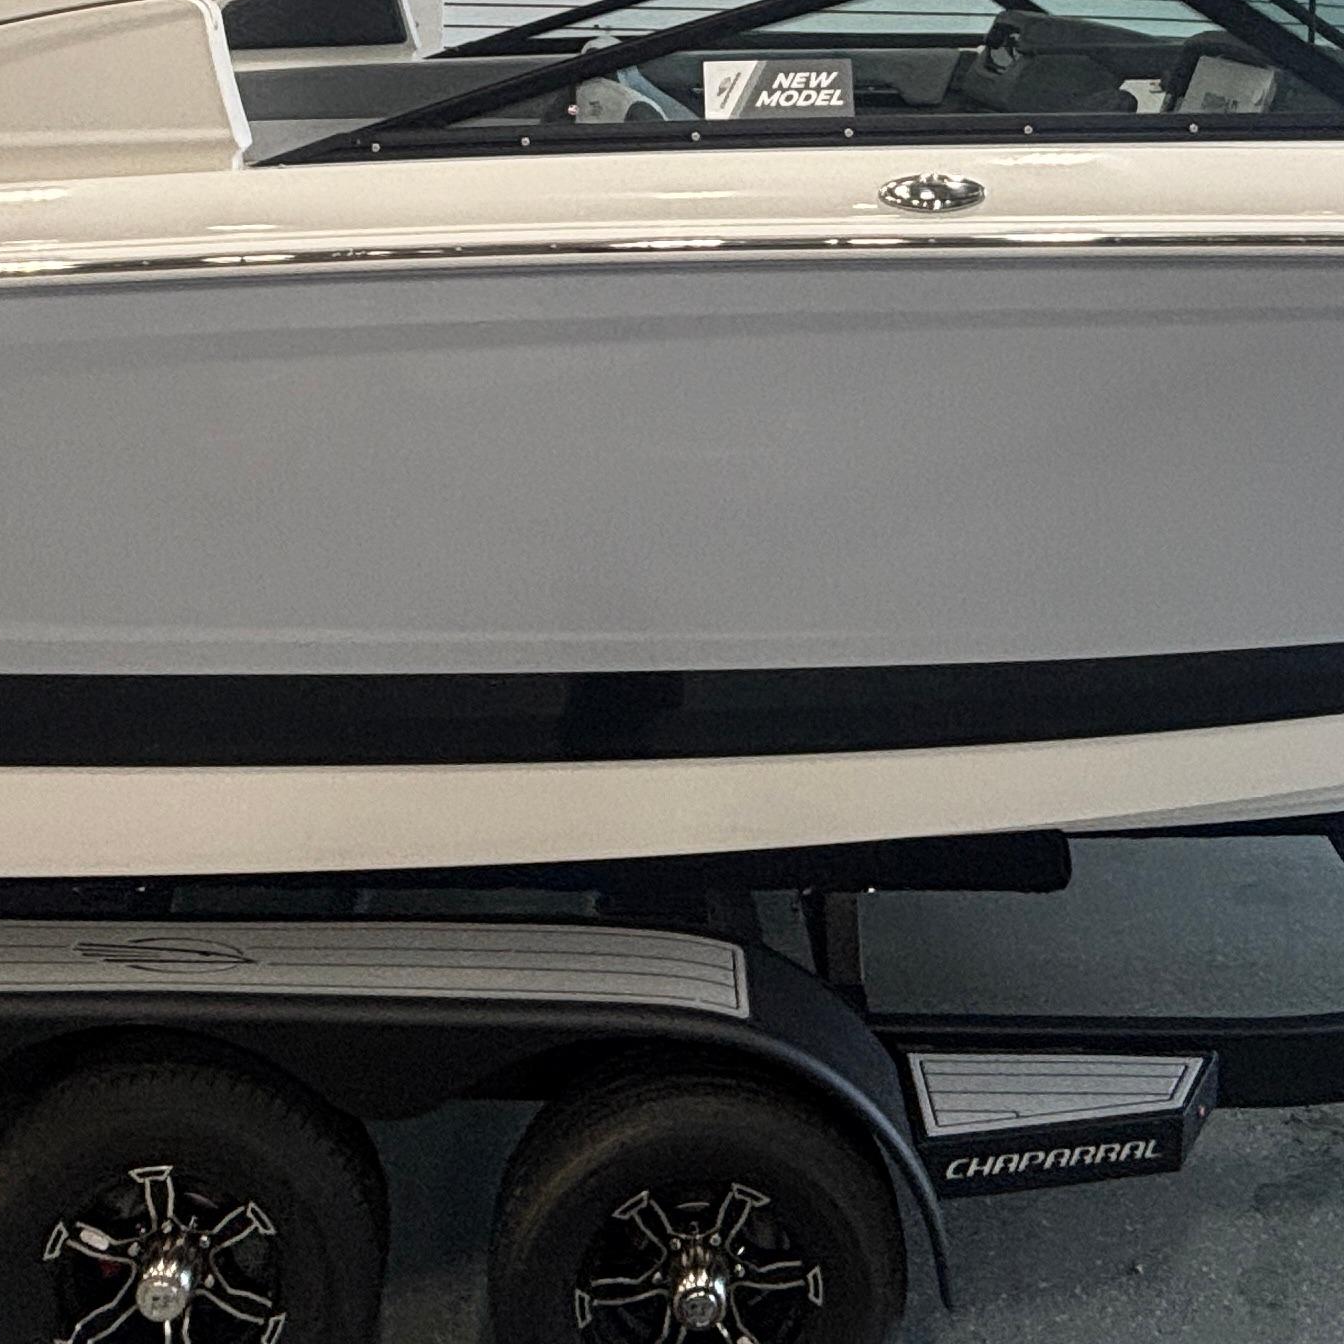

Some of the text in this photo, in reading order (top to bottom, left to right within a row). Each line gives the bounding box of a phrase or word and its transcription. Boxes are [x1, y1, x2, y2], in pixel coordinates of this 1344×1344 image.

[771, 71, 839, 90] NEW
[755, 89, 845, 108] MODEL
[945, 1138, 1162, 1181] CHAPARRAL
